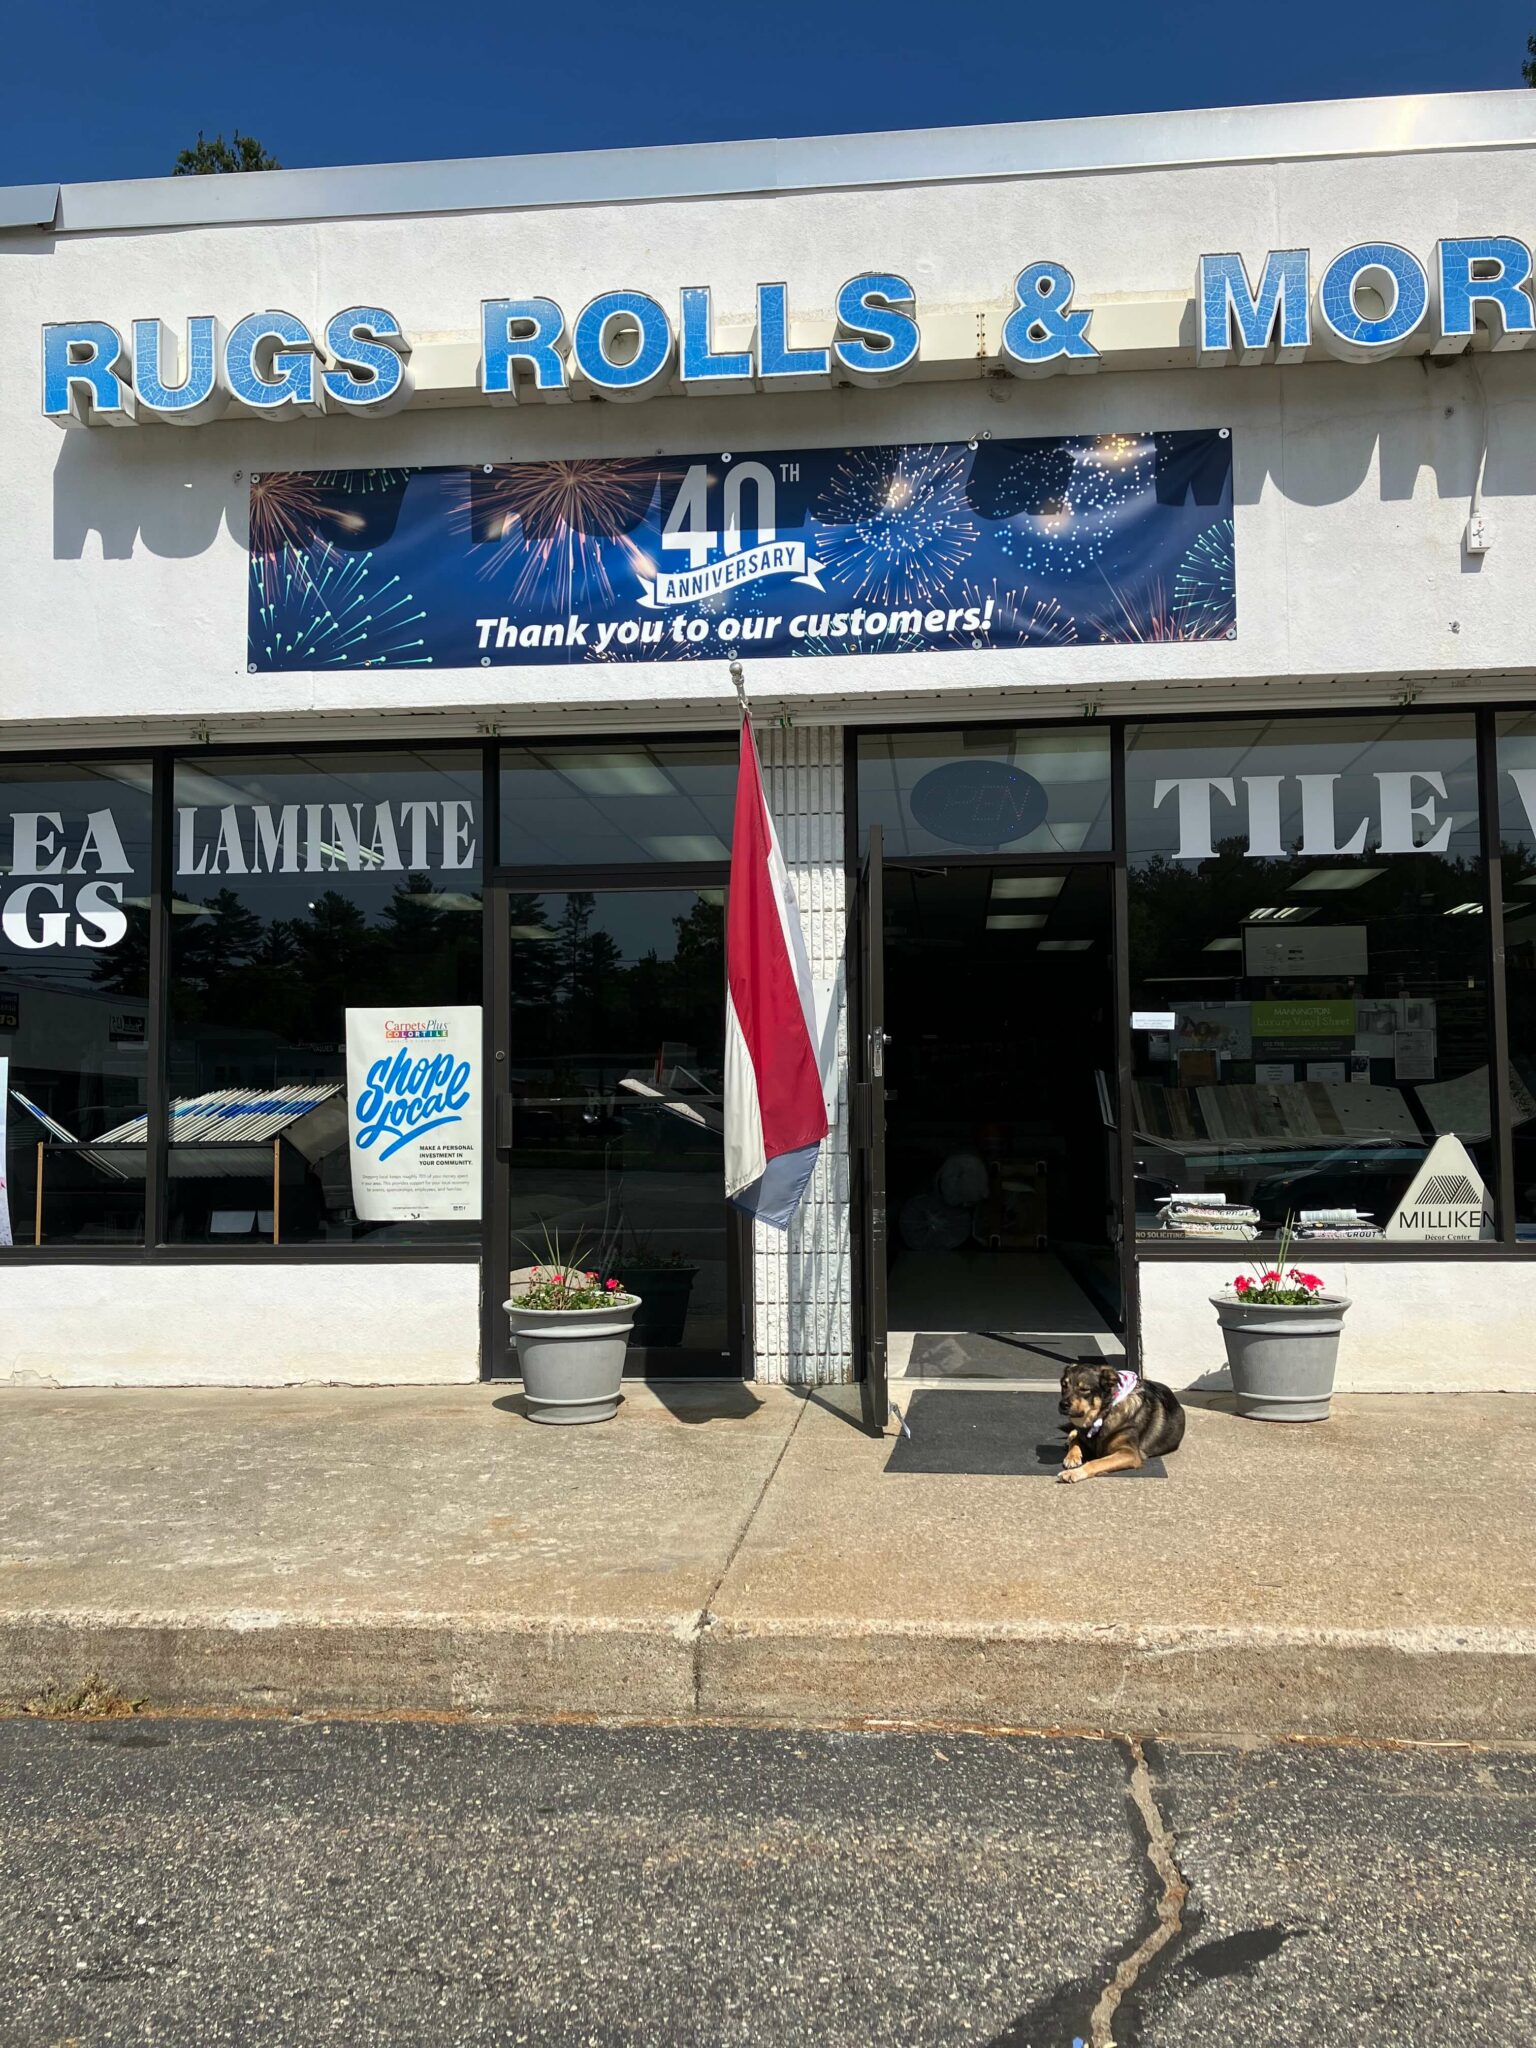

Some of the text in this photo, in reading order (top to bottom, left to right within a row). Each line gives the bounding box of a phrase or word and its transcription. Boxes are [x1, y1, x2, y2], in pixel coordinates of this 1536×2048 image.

[42, 235, 1536, 417] RUGS ROLLS & MOR
[665, 546, 796, 598] ANNIVERSARY
[475, 599, 996, 654] Thank you to our customers!
[176, 800, 477, 876] LAMINATE
[1153, 770, 1453, 859] TILE
[0, 807, 135, 876] EA
[0, 880, 128, 949] GS
[386, 1030, 448, 1038] COLORTILE
[1293, 1016, 1320, 1028] Vinyl
[1135, 1231, 1146, 1239] NO
[1146, 1231, 1185, 1239] SOLICITING
[1399, 1210, 1496, 1229] MILLIKEN
[1447, 1233, 1472, 1241] Center
